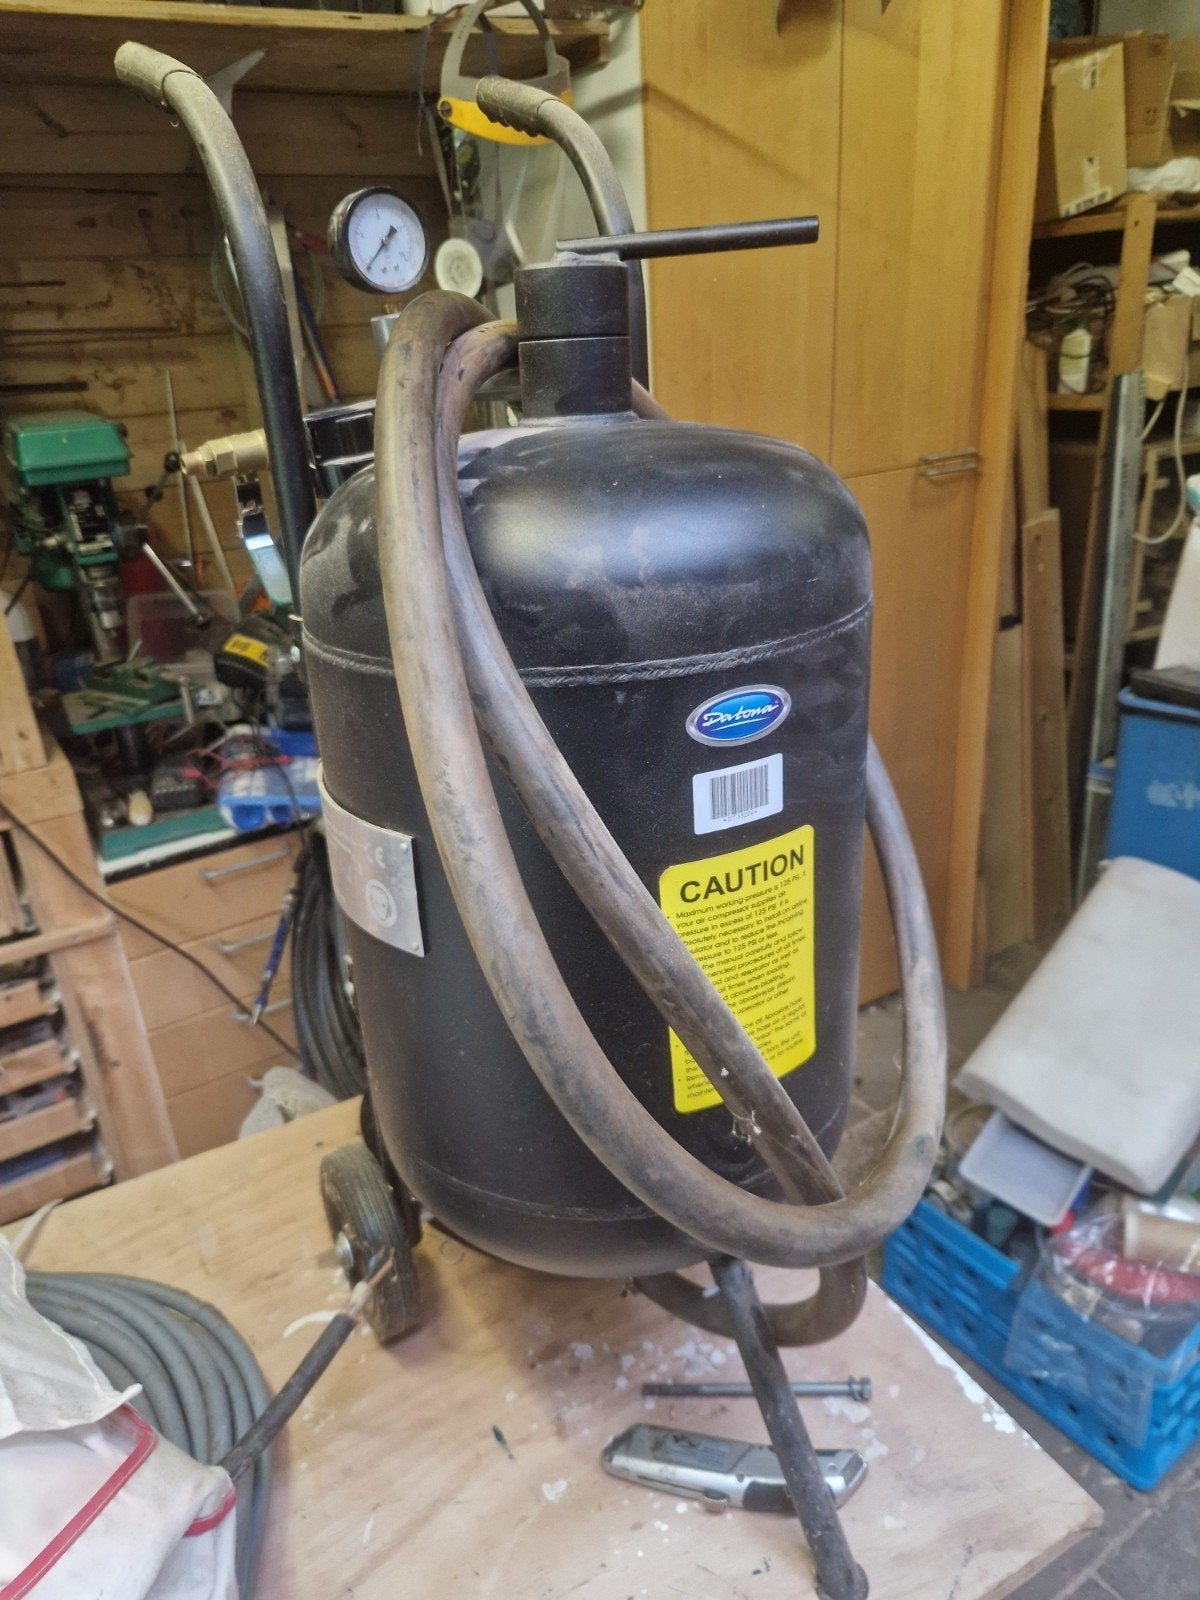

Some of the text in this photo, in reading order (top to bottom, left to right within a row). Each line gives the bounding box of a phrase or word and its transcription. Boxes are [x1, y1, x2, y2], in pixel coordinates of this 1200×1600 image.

[702, 704, 779, 727] Datona
[680, 845, 804, 904] CAUTION
[676, 906, 714, 919] Maximum
[716, 897, 744, 910] working
[745, 887, 773, 902] pressure
[780, 877, 791, 888] 125
[676, 890, 786, 930] your air compressor supplies air
[683, 933, 717, 946] bsolutely
[719, 922, 754, 938] necessary
[756, 918, 763, 926] to
[764, 910, 781, 923] install
[711, 923, 718, 931] in
[720, 917, 744, 928] excess
[745, 912, 753, 920] of
[755, 906, 767, 917] 125
[715, 938, 730, 949] and
[732, 936, 739, 944] to
[741, 928, 765, 940] reduce
[766, 922, 776, 931] the
[777, 909, 804, 926] incoming
[696, 950, 722, 962] ressure
[724, 948, 731, 956] to
[733, 942, 746, 952] 125
[748, 938, 757, 947] PSI
[758, 936, 765, 944] or
[716, 953, 744, 967] manual
[745, 942, 772, 958] carefully
[774, 936, 787, 947] and
[738, 954, 775, 970] procedures
[776, 946, 783, 954] at
[724, 973, 739, 983] and
[740, 961, 770, 977] respirator
[771, 957, 779, 965] as
[780, 950, 791, 960] well
[728, 980, 745, 990] times
[748, 972, 765, 983] when
[737, 998, 765, 1015] operator
[766, 994, 774, 1002] or
[774, 987, 788, 999] other
[687, 1087, 715, 1099] mainten
